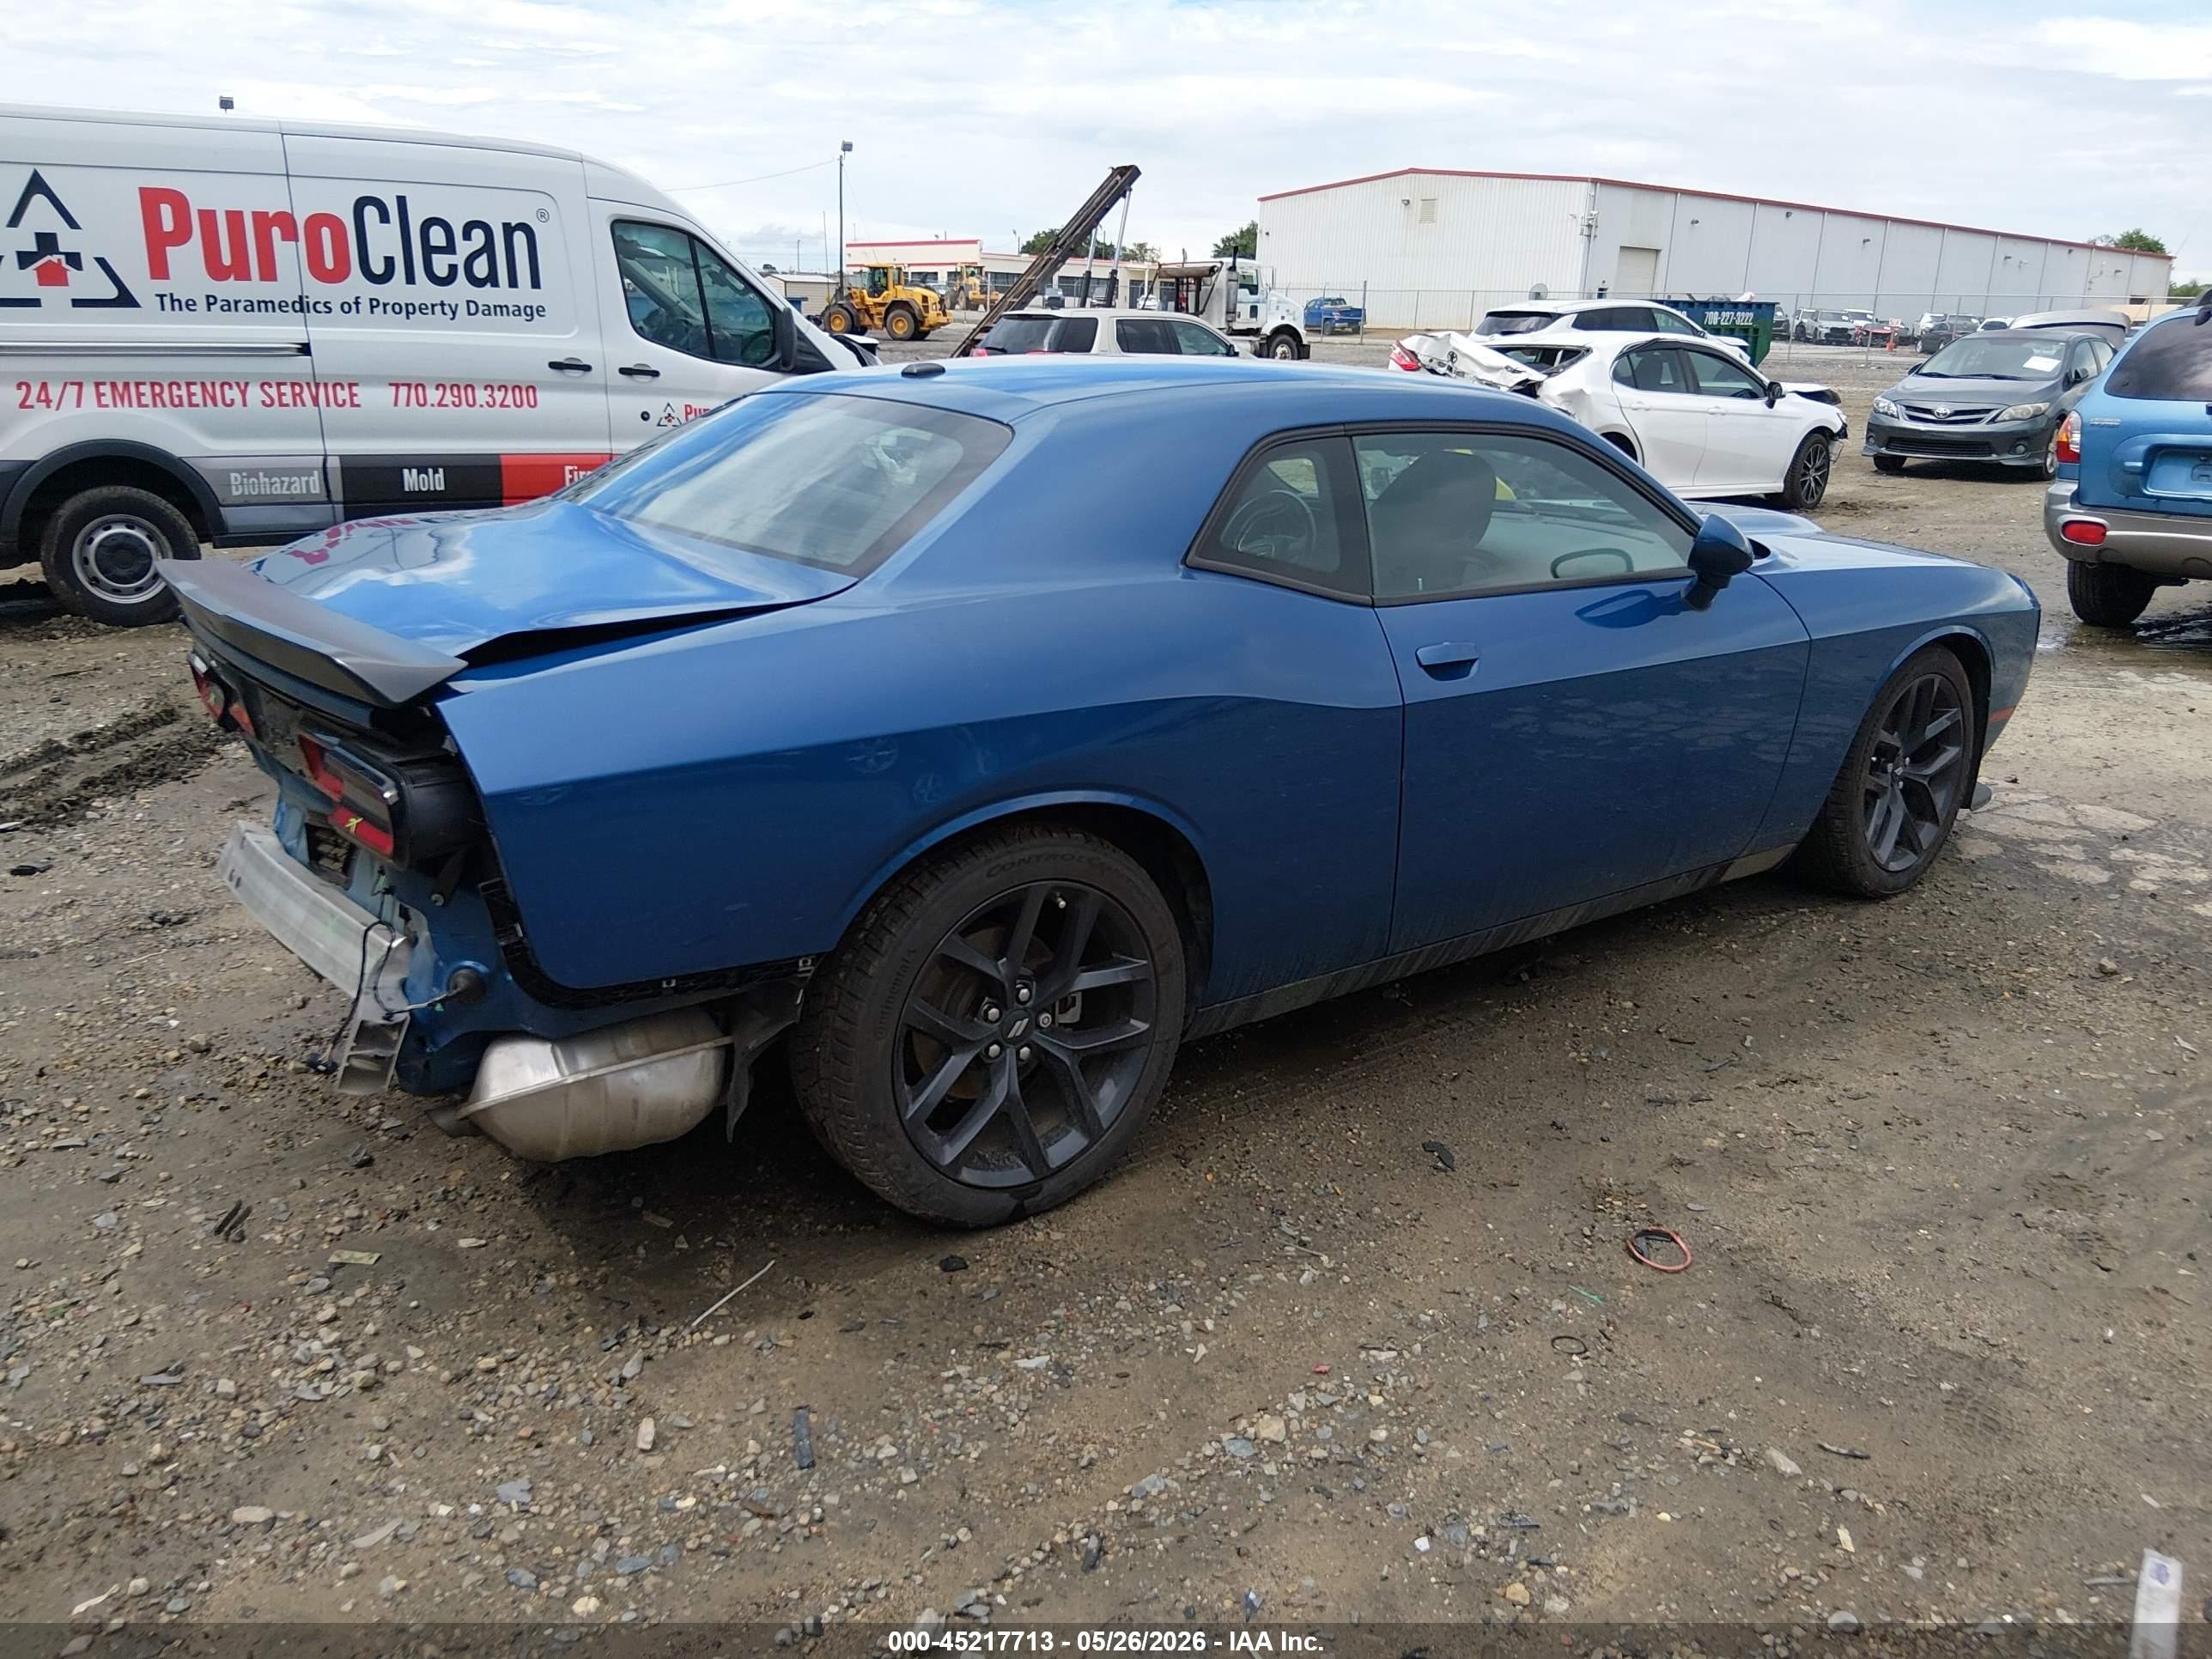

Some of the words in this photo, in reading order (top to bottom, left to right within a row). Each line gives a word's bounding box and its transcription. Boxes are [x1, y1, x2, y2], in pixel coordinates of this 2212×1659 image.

[156, 294, 197, 314] The
[206, 295, 332, 315] Paramedics
[340, 296, 362, 316] of
[369, 297, 459, 322] Property
[466, 300, 546, 321] Damage
[16, 381, 84, 410] 24/7
[94, 381, 250, 410] EMERGENCY
[261, 381, 361, 409] SERVICE
[390, 382, 538, 410] 770.290.3200
[230, 471, 320, 496] Biohazard
[404, 467, 445, 492] Mold
[564, 465, 592, 487] Fir
